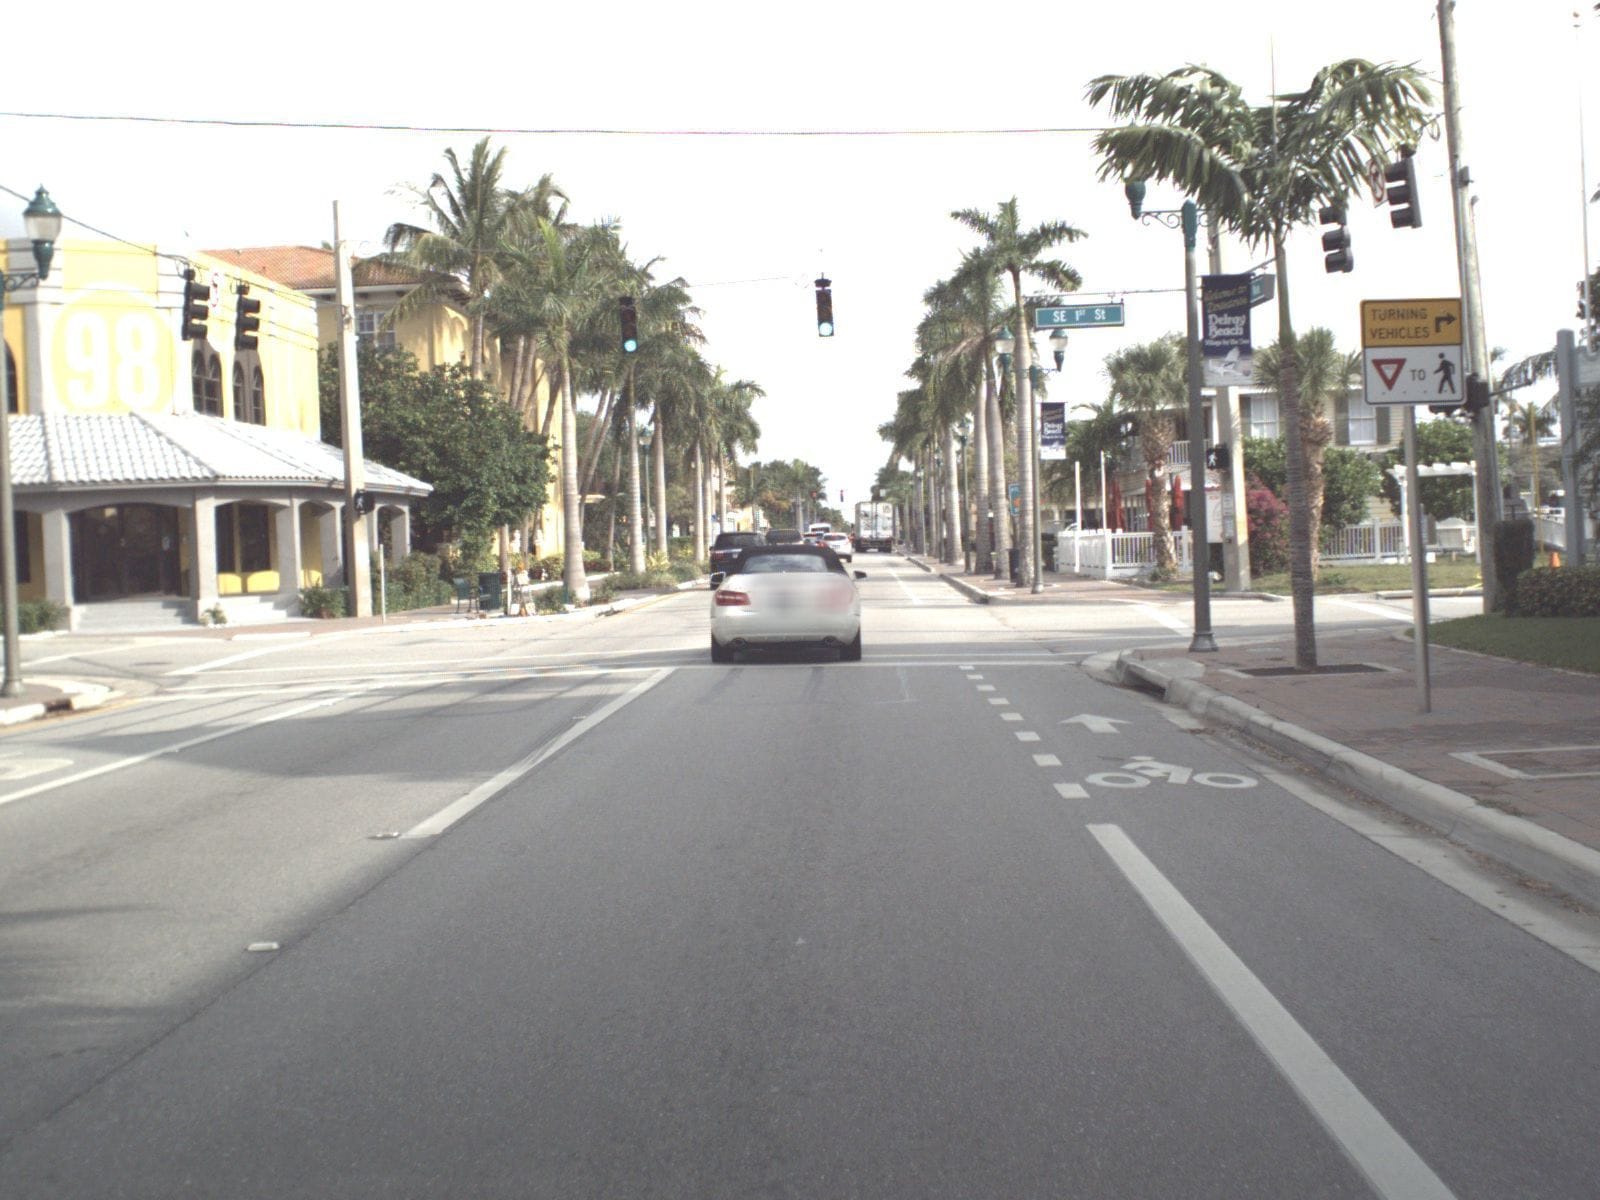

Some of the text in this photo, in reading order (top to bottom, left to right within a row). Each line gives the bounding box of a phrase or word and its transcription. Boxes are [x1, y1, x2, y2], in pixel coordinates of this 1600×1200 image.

[1053, 310, 1067, 322] SE
[1094, 308, 1107, 320] St
[1208, 313, 1247, 326] Delray
[1371, 308, 1428, 321] TURNING
[1208, 324, 1243, 338] Beach
[1371, 326, 1430, 340] VEHICLES
[64, 311, 160, 408] 98
[1410, 369, 1426, 381] TO
